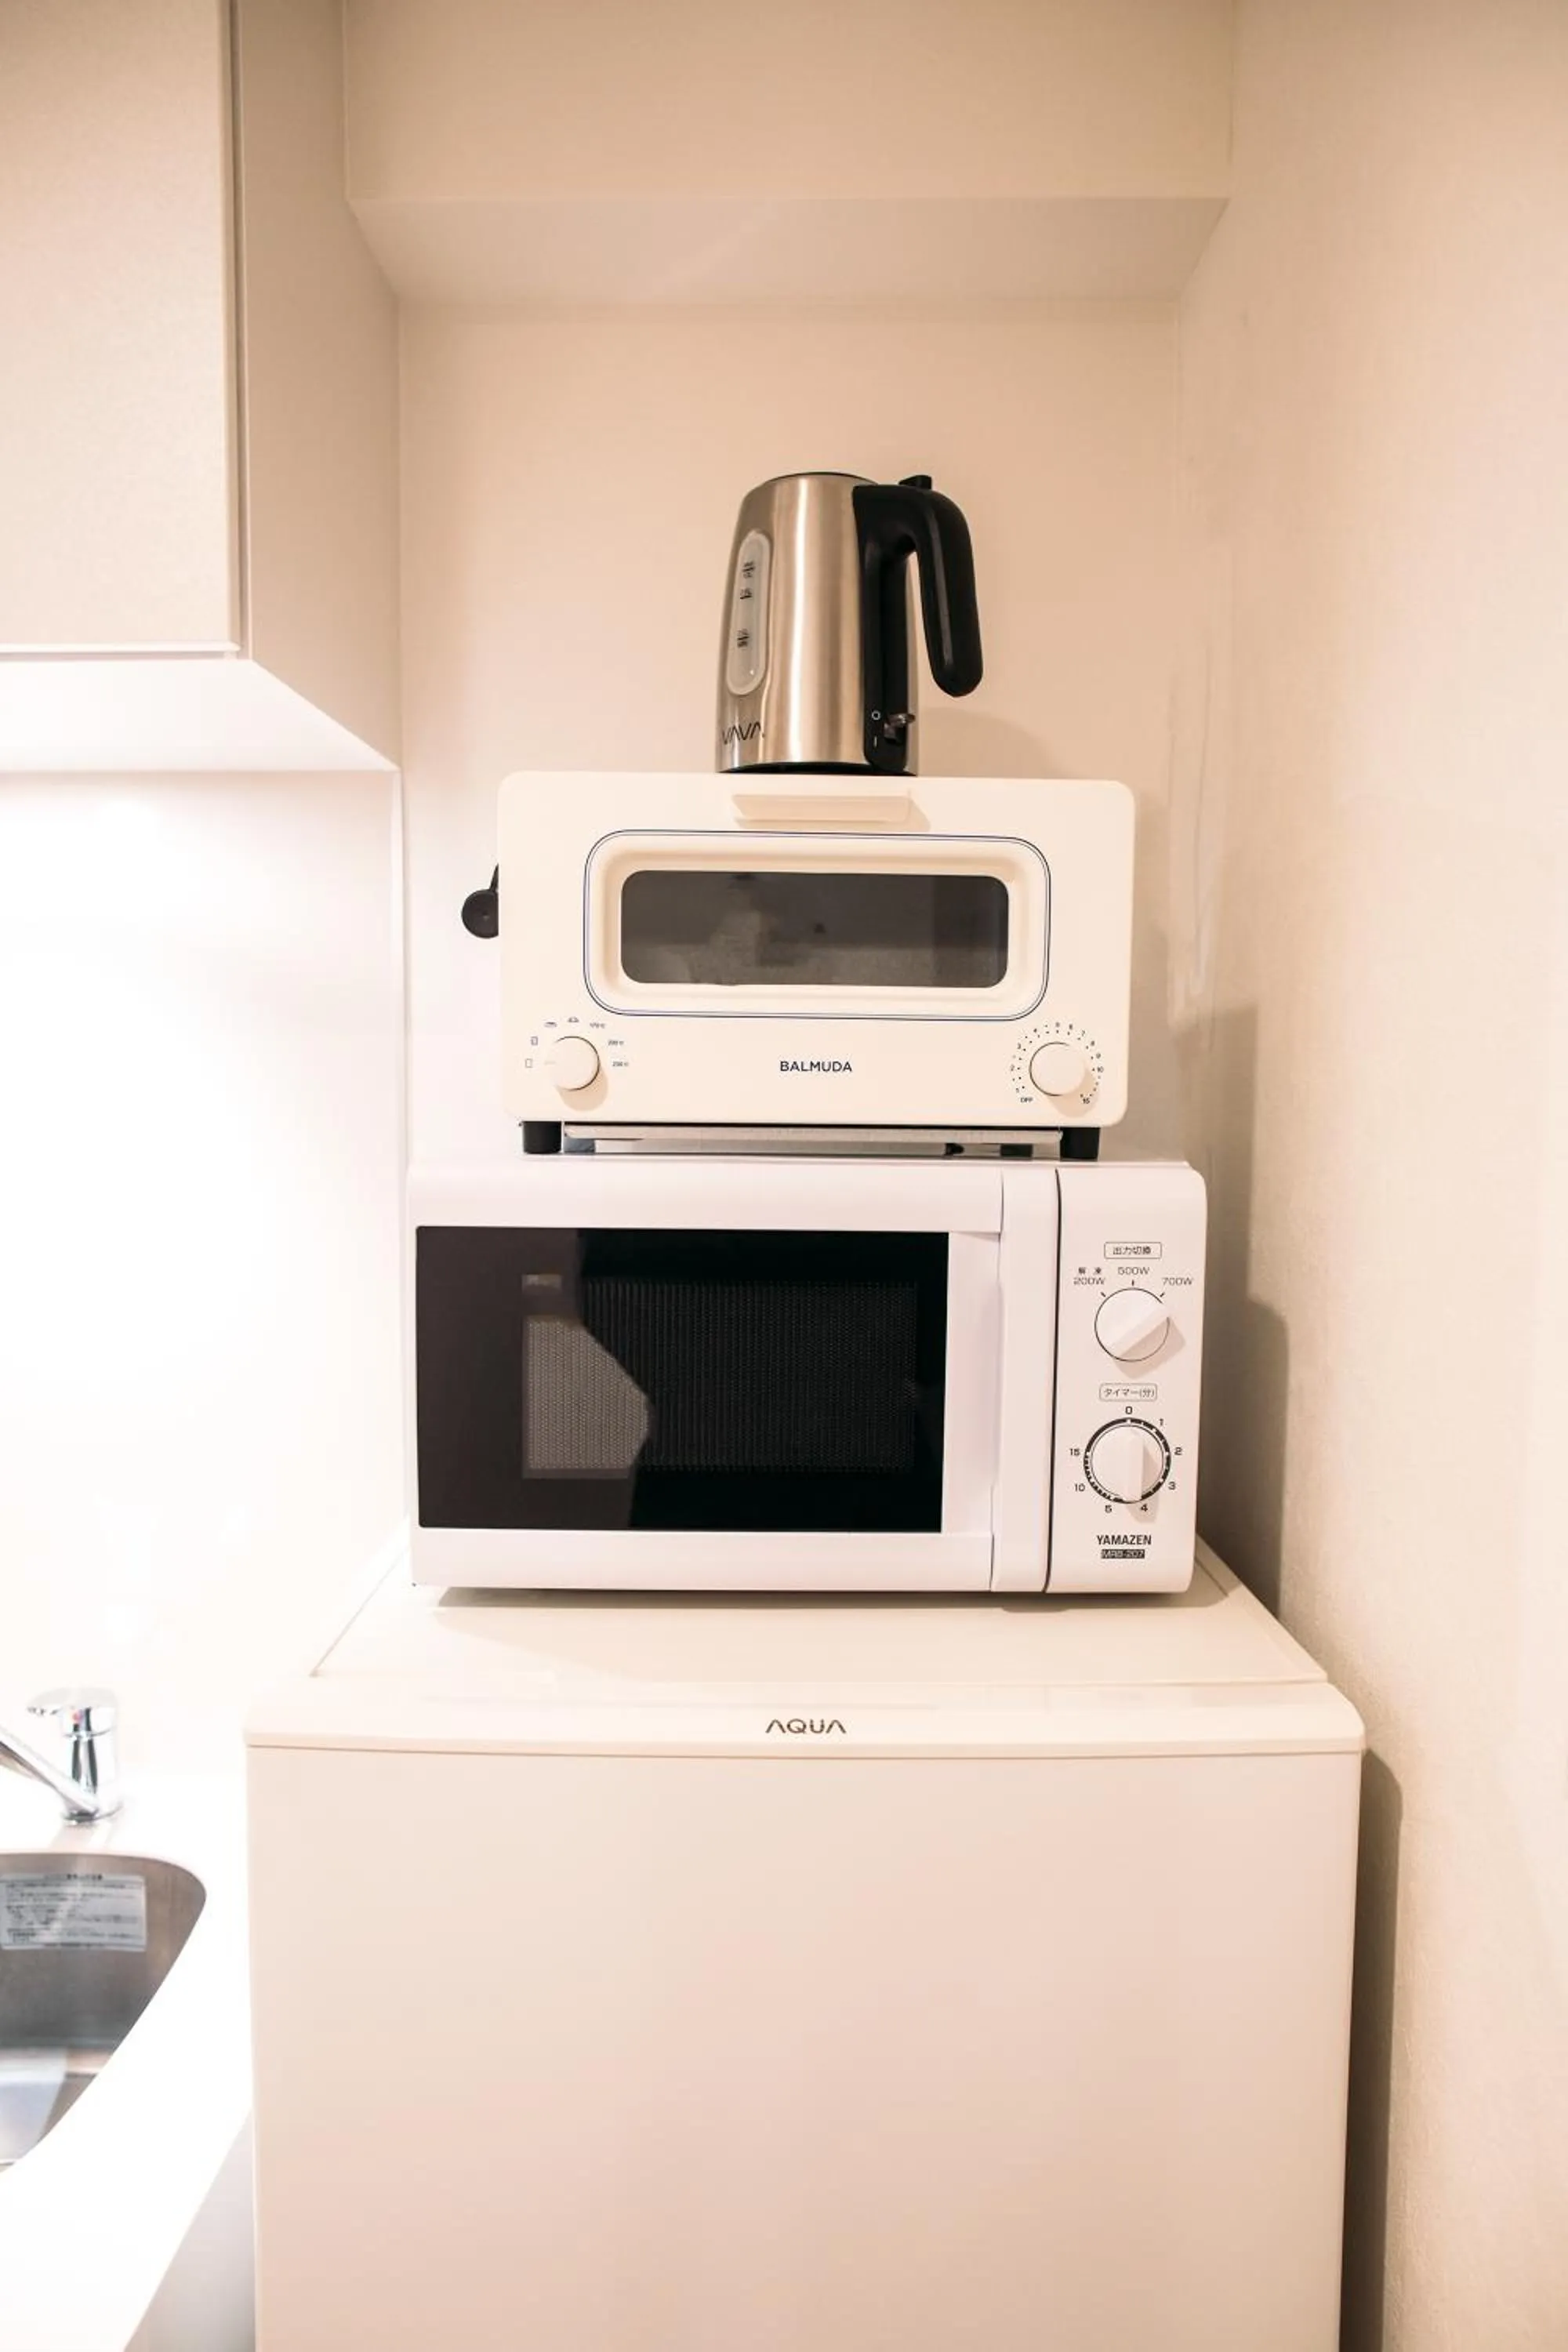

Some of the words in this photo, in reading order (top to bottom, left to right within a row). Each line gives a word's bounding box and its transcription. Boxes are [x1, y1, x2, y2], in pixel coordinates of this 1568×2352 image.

[780, 1061, 852, 1072] BALMUDA
[1117, 1266, 1150, 1276] 500W
[1073, 1277, 1106, 1286] 200W
[1162, 1277, 1194, 1286] 700W
[1070, 1448, 1080, 1457] 15
[1140, 1504, 1148, 1512] 4
[1097, 1534, 1152, 1545] YAMAZEN
[765, 1718, 847, 1733] AQUA
